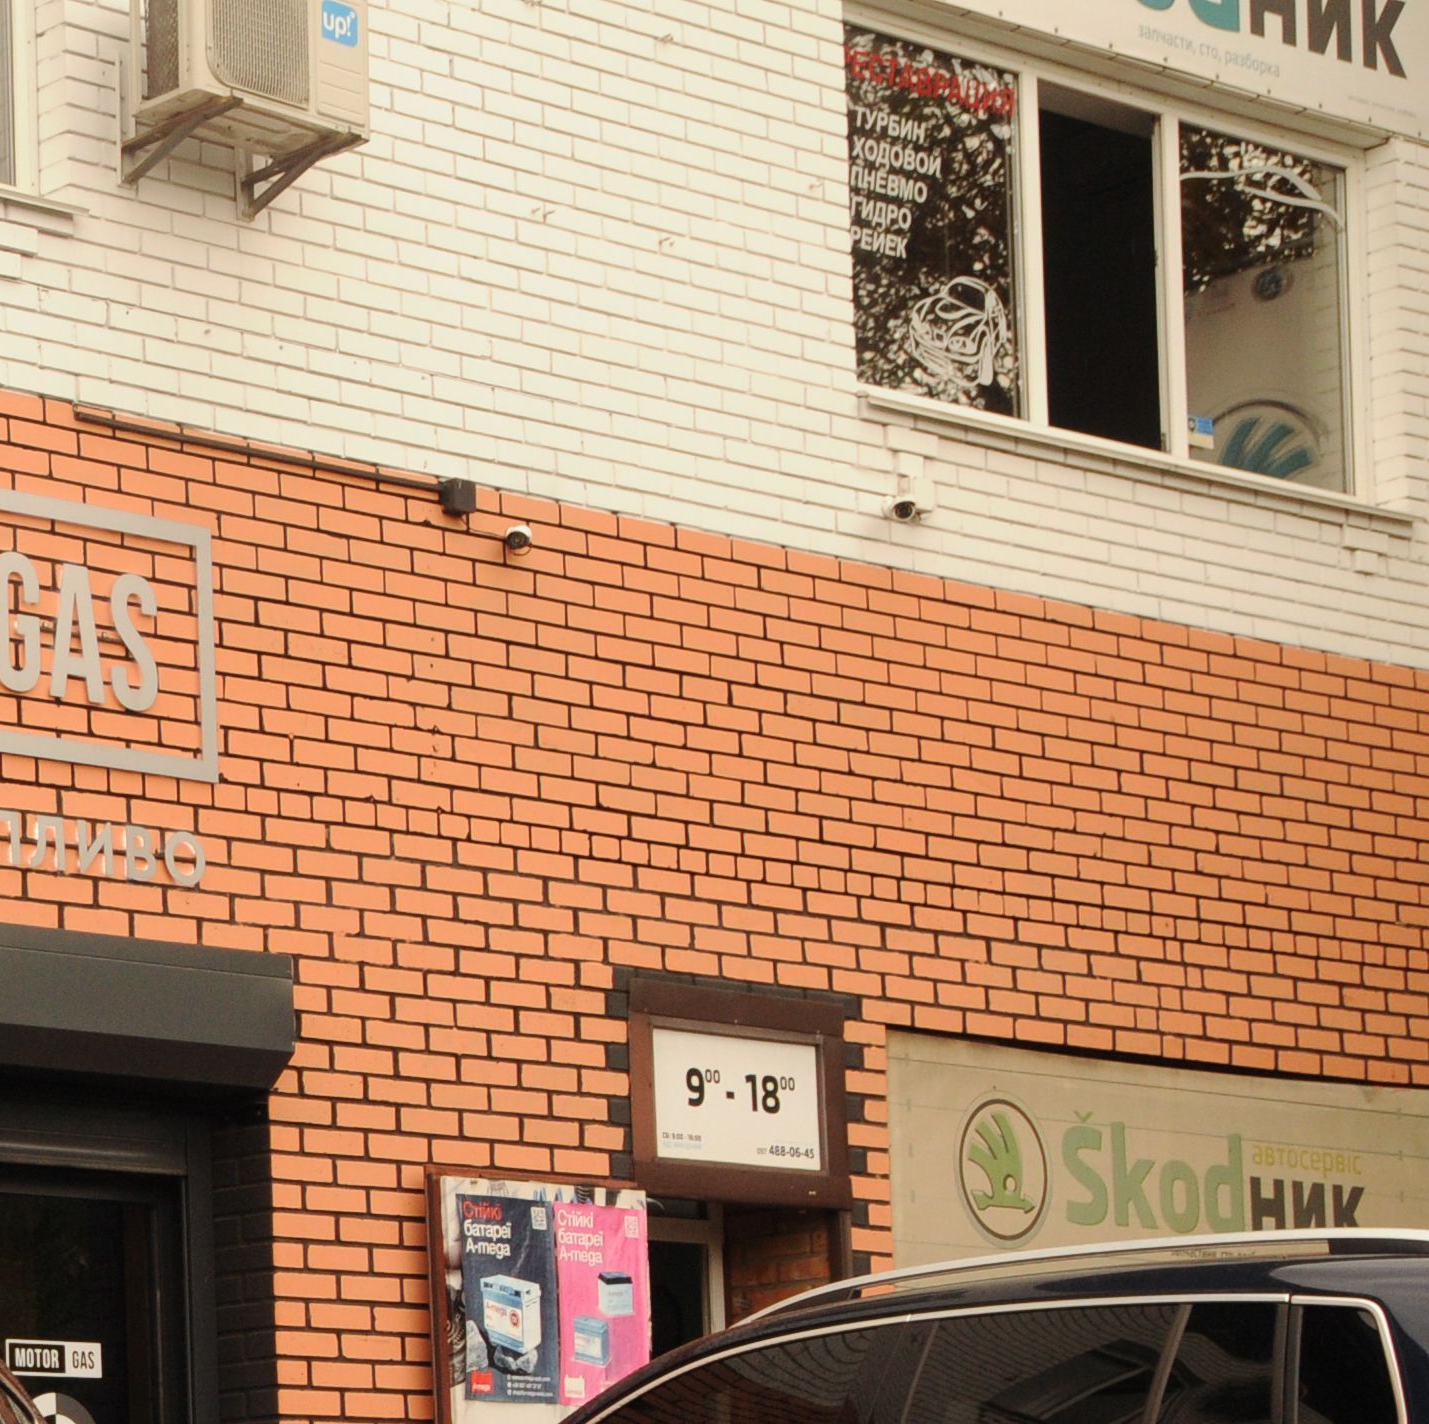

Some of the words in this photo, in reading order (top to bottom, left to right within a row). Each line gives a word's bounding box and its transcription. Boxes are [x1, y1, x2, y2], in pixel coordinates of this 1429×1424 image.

[1224, 50, 1281, 78] разборка
[854, 106, 926, 145] ТУРБИН
[852, 134, 942, 178] ХОДОВОЙ
[850, 166, 928, 203] ПНЕВМО
[850, 196, 912, 231] ГИДРО
[769, 1144, 814, 1159] 488-06-45
[1252, 1144, 1363, 1178] автосервіс
[463, 1200, 501, 1220] Стійкі
[558, 1209, 594, 1228] Стійкі
[463, 1219, 512, 1241] батареї
[558, 1227, 604, 1249] батареї
[466, 1237, 511, 1259] A-mega
[559, 1246, 604, 1267] A-mega
[14, 1347, 59, 1369] MOTOR
[72, 1350, 95, 1370] GAS
